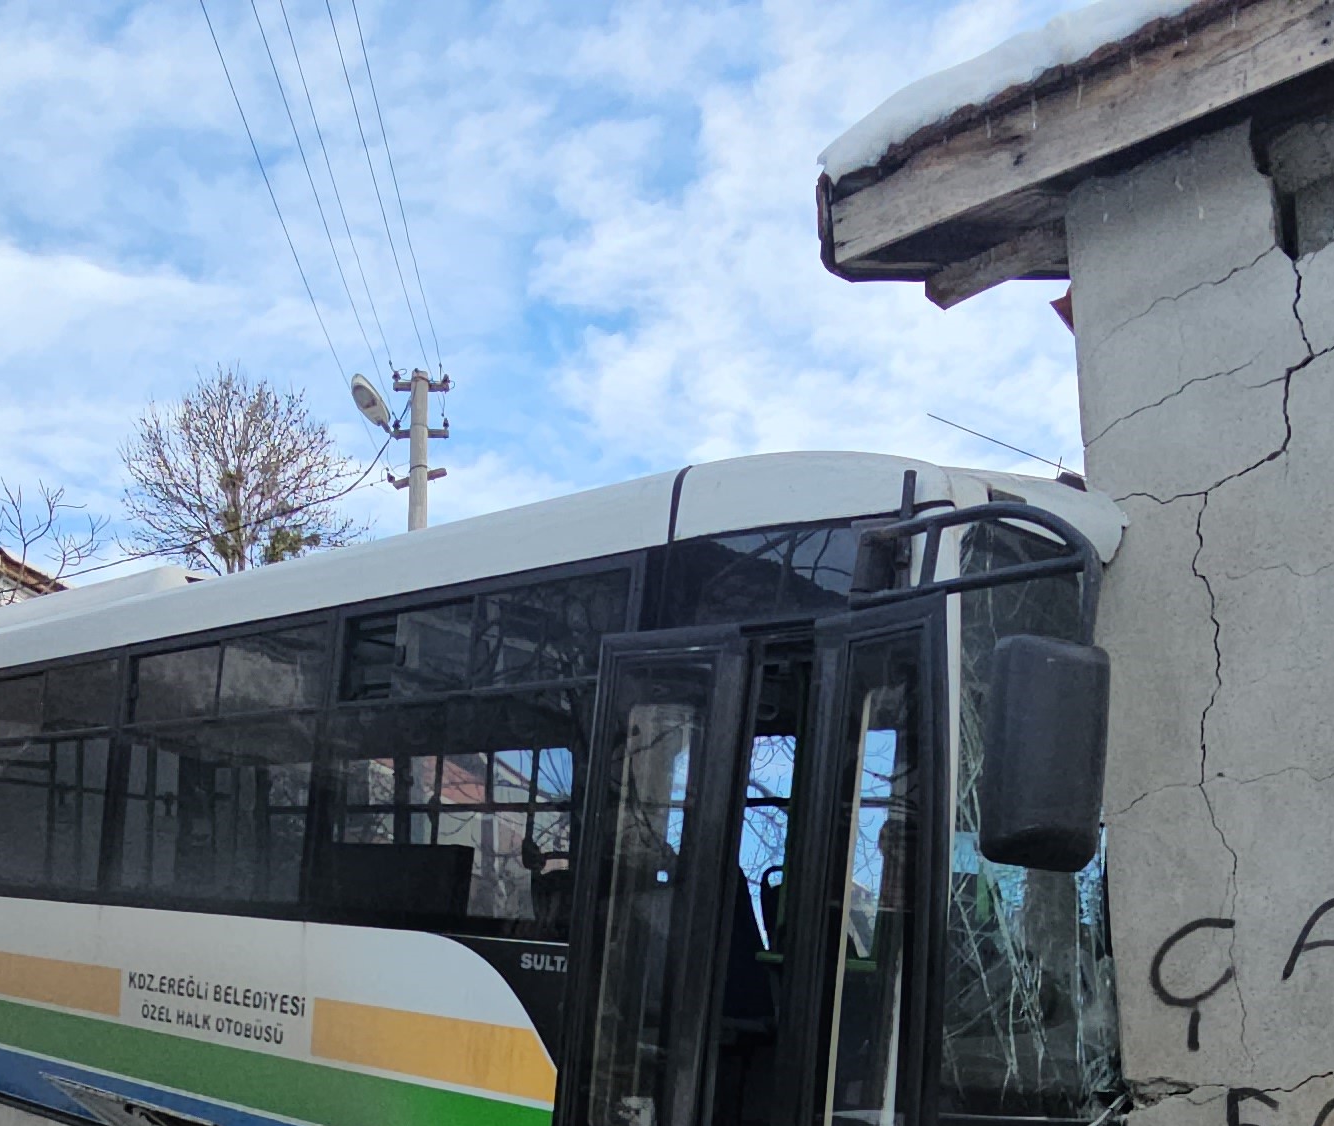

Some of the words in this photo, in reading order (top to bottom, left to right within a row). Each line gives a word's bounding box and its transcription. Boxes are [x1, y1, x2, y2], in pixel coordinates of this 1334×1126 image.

[141, 999, 172, 1023] ÖZEL
[176, 1009, 211, 1031] HALK
[215, 1018, 284, 1045] OTOBÜSÜ
